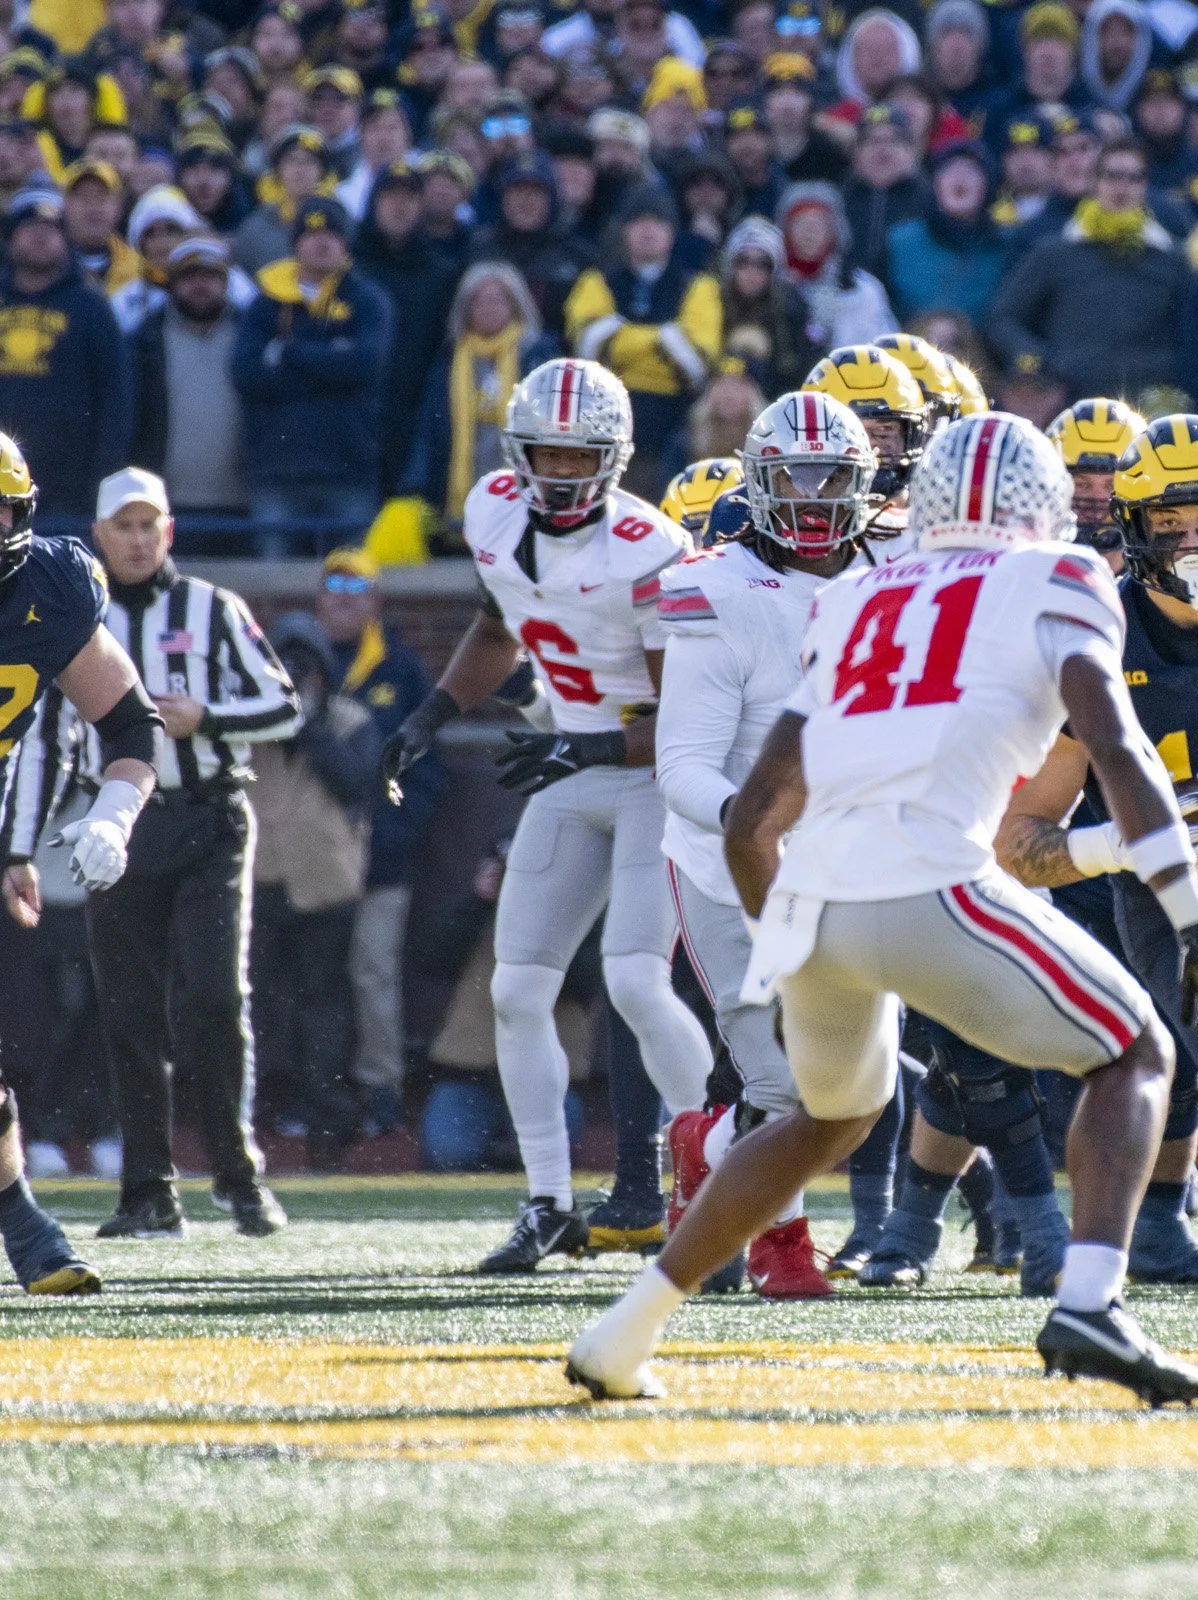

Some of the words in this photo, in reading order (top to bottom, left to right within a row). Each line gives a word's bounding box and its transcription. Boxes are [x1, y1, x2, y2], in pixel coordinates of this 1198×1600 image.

[612, 517, 654, 543] 6
[520, 617, 606, 707] 6
[832, 574, 987, 718] 41
